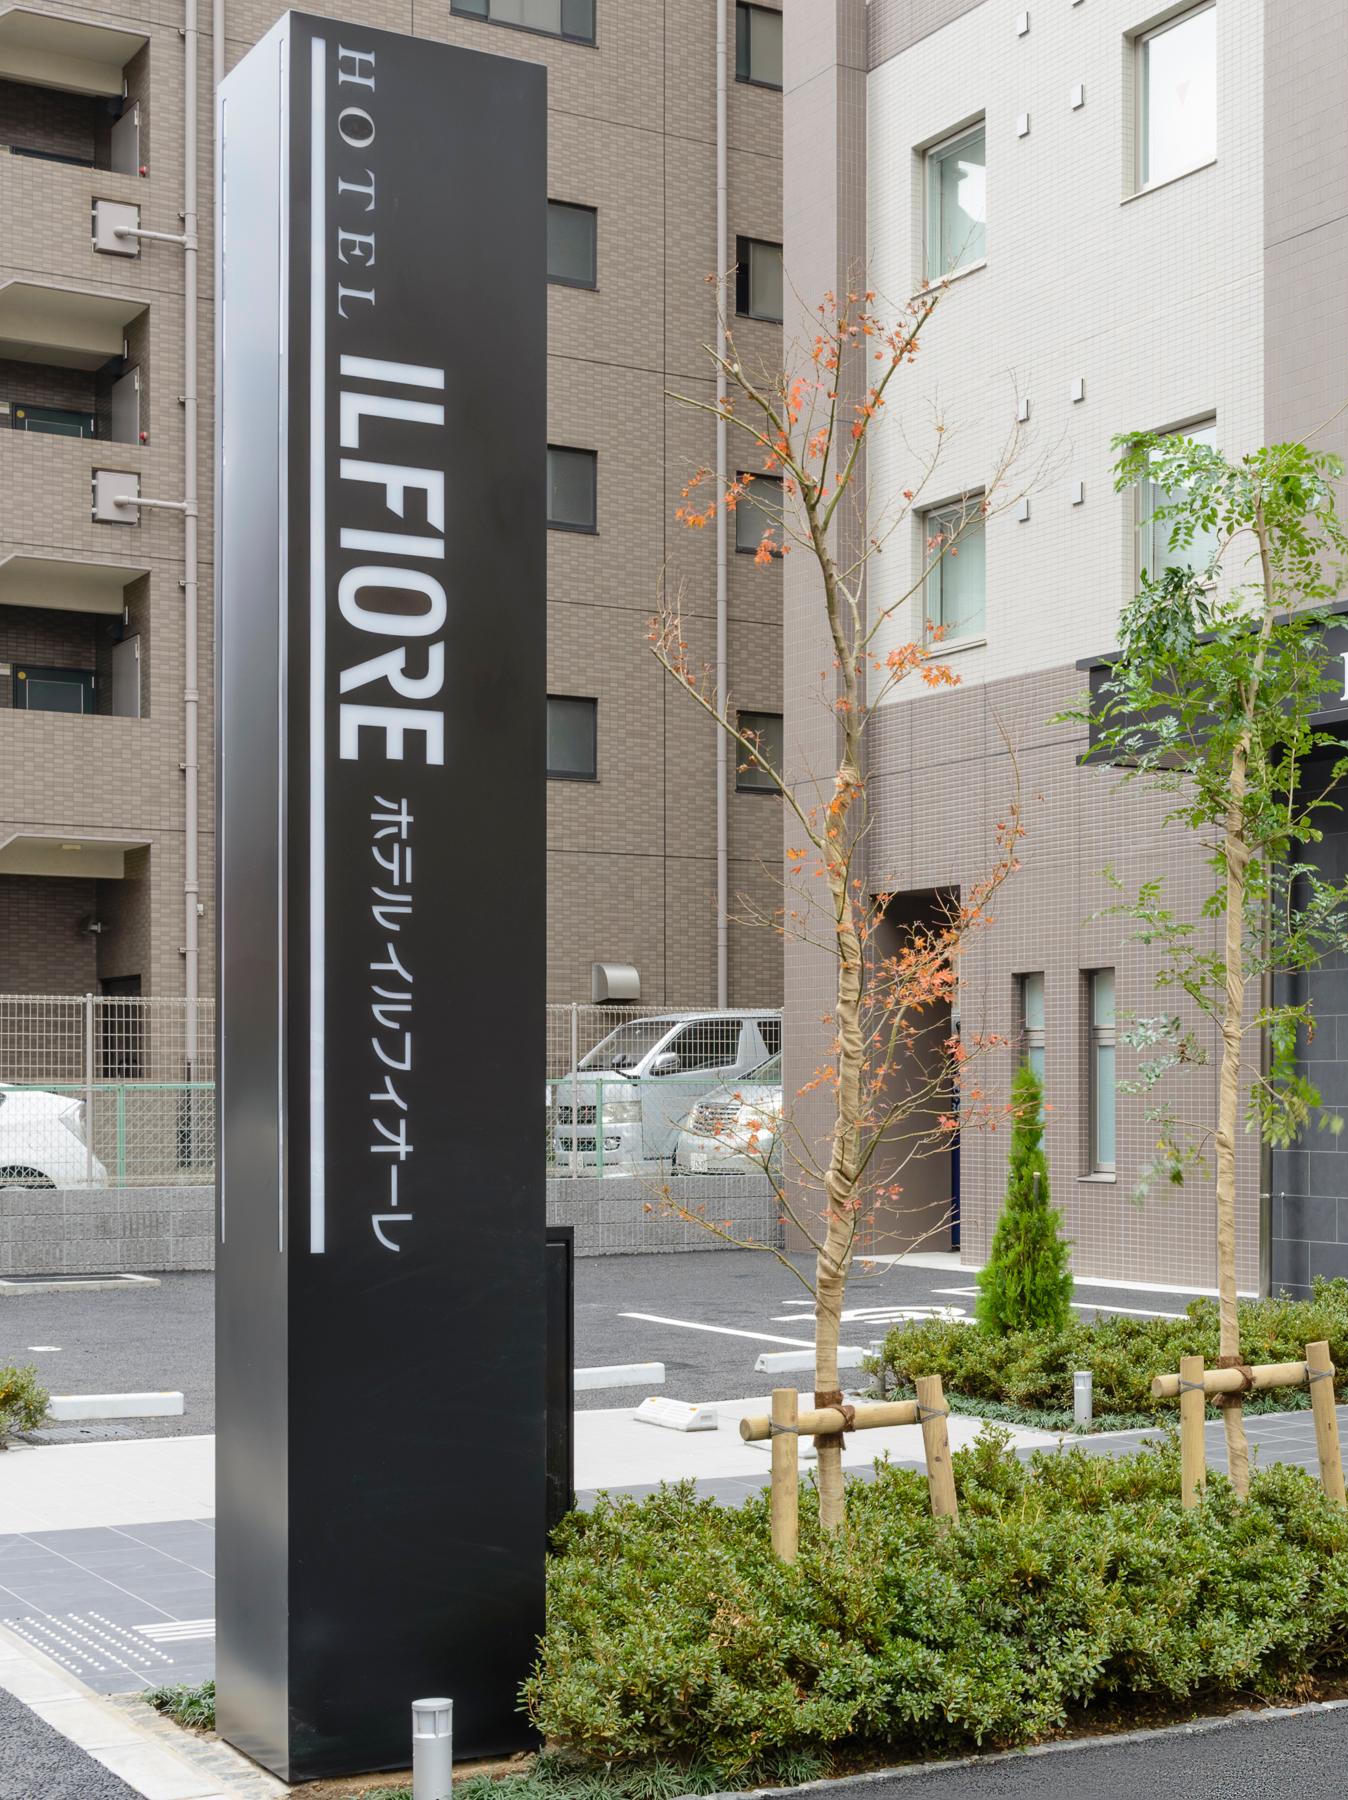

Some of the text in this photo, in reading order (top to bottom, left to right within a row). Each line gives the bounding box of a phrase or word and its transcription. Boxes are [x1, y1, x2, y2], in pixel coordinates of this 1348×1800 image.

[338, 44, 447, 766] HOTEL ILFIORE
[369, 795, 414, 1252] ホテルイルフィオーレ
